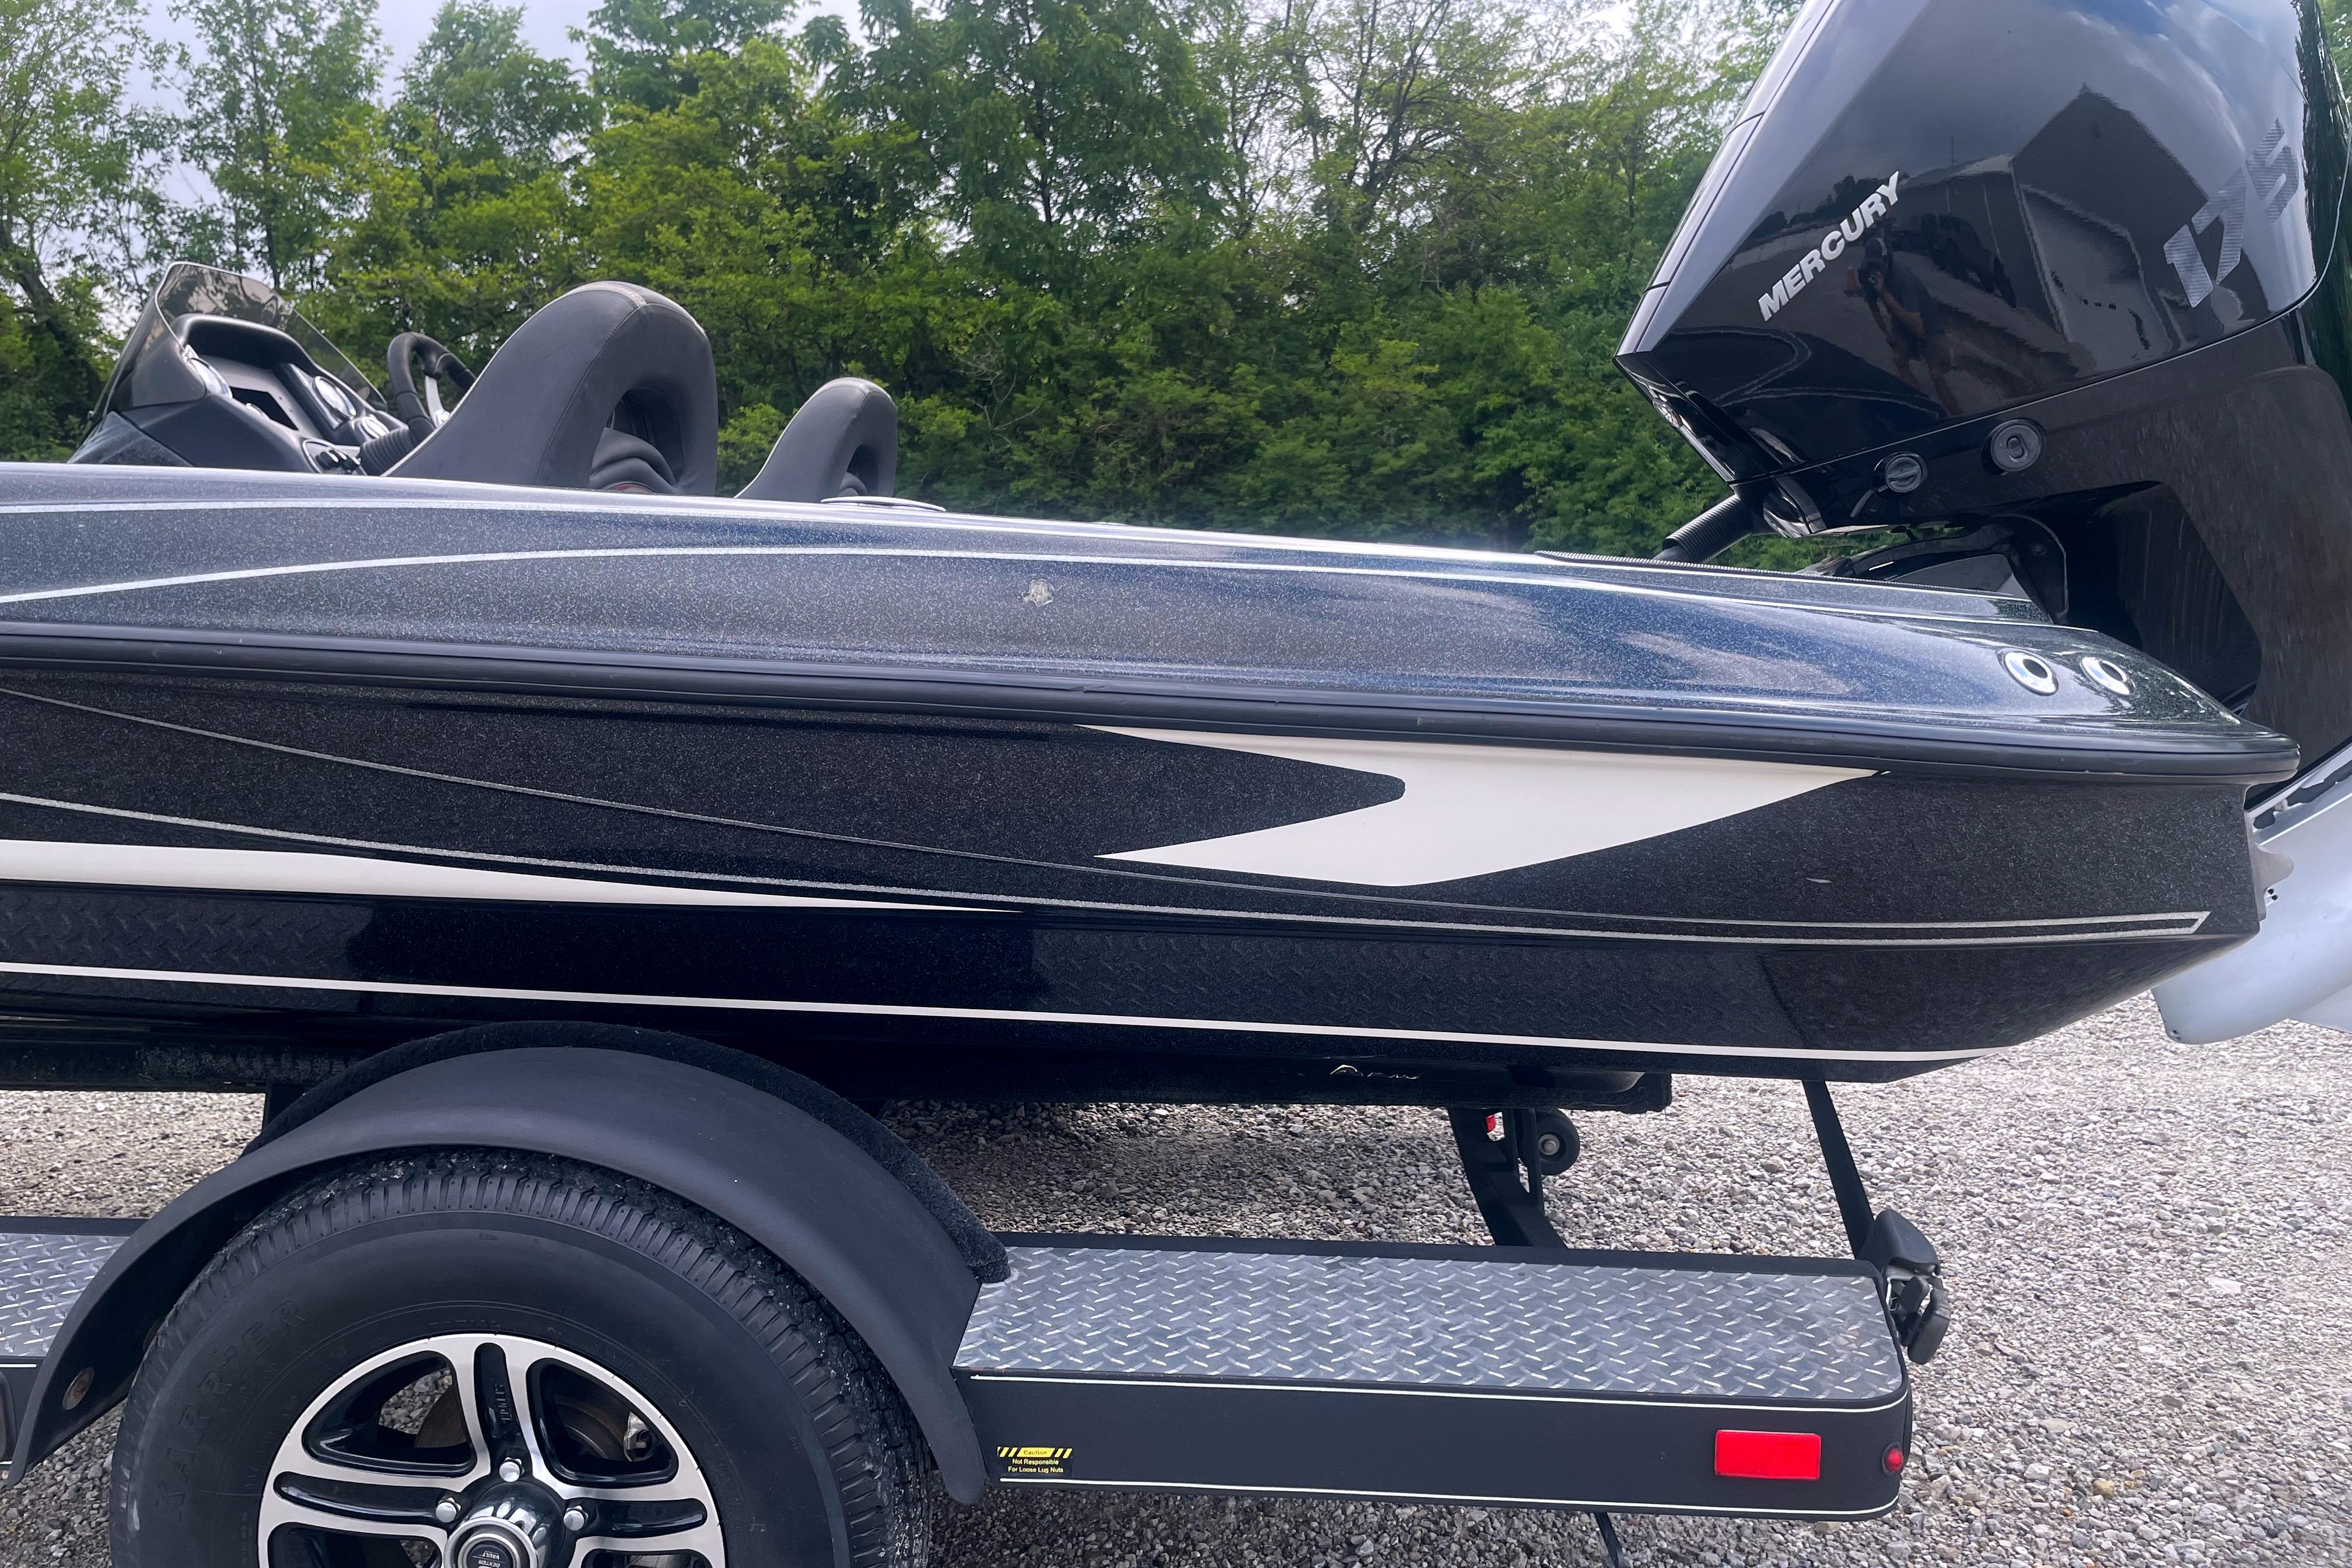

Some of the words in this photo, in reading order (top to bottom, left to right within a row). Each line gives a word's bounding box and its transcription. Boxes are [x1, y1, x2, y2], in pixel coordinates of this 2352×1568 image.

[1758, 170, 1899, 322] MERCURY
[2163, 117, 2300, 309] 175
[478, 1559, 501, 1568] DEXTER
